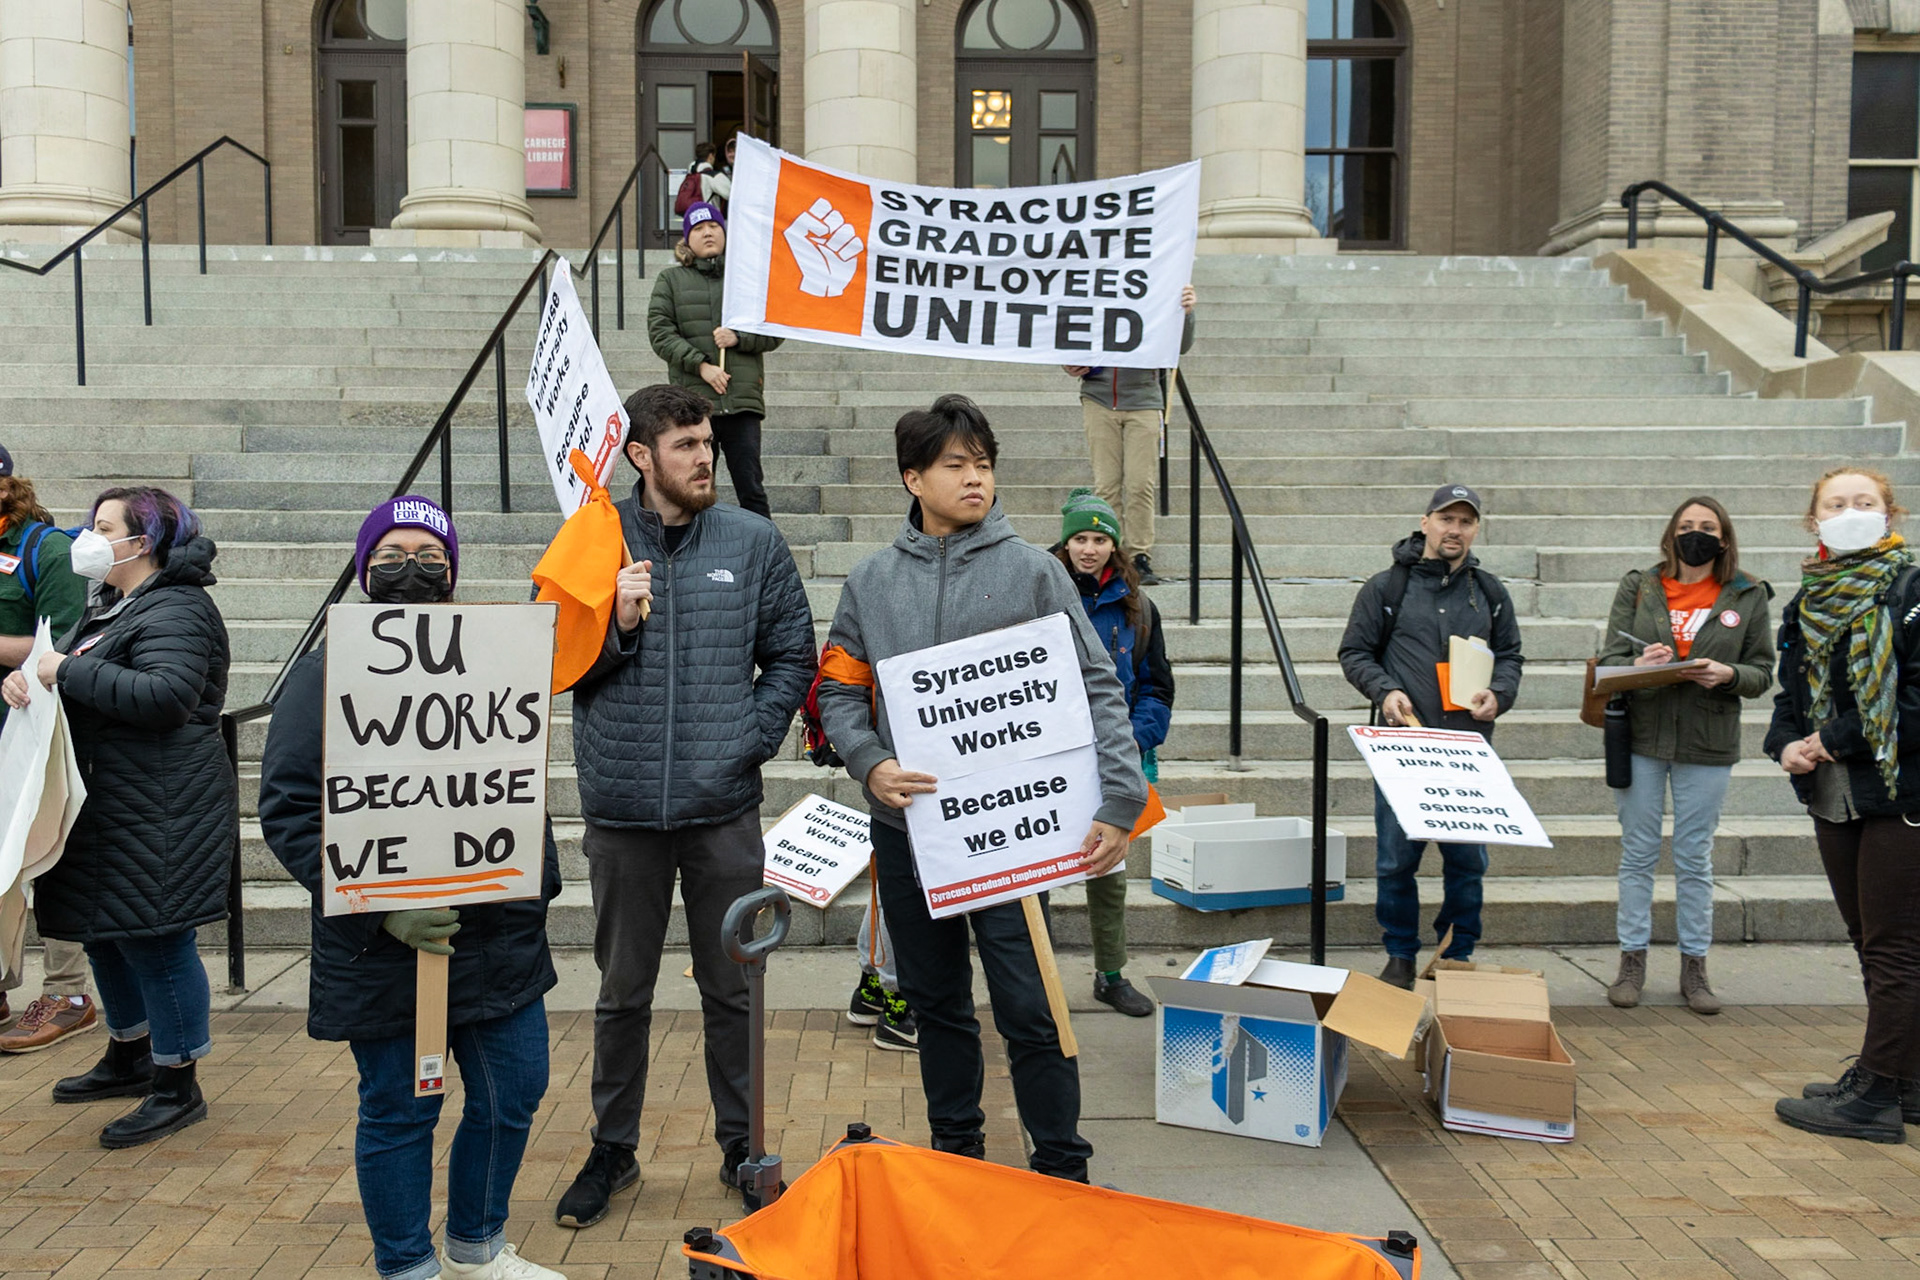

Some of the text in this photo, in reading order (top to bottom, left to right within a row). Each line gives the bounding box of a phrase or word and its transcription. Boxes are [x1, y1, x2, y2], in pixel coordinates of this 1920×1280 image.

[524, 137, 567, 149] CARNEGIE
[527, 151, 564, 163] LIBRARY
[880, 186, 1156, 225] SYRACUSE
[878, 218, 1153, 260] GRADUATE
[875, 255, 1149, 300] EMPLOYEES
[530, 291, 561, 389] Syracuse
[873, 291, 1144, 353] UNITED
[535, 311, 569, 412] University
[546, 354, 571, 418] Works
[556, 383, 589, 475] Because
[578, 413, 593, 453] do!
[393, 501, 447, 521] UNIONS
[396, 510, 447, 535] FOR ALL
[367, 608, 467, 676] SU
[912, 646, 1048, 695] Syracuse
[340, 687, 541, 751] WORKS
[918, 679, 1058, 729] University
[951, 720, 1042, 756] Works
[1369, 743, 1489, 758] a union now!
[1398, 758, 1480, 773] We want
[326, 768, 536, 814] BECAUSE
[940, 775, 1068, 821] Because
[1418, 802, 1510, 818] because
[1424, 786, 1486, 798] we do
[804, 812, 871, 844] University
[815, 803, 871, 828] Syracus
[964, 809, 1061, 853] we do!
[1424, 818, 1523, 836] SU works
[326, 827, 515, 881] WE DO
[777, 839, 839, 868] Because
[806, 826, 848, 849] Works
[773, 853, 822, 877] we do!
[931, 884, 972, 903] Syracuse
[971, 876, 1012, 894] Graduate
[1011, 863, 1058, 884] Employees
